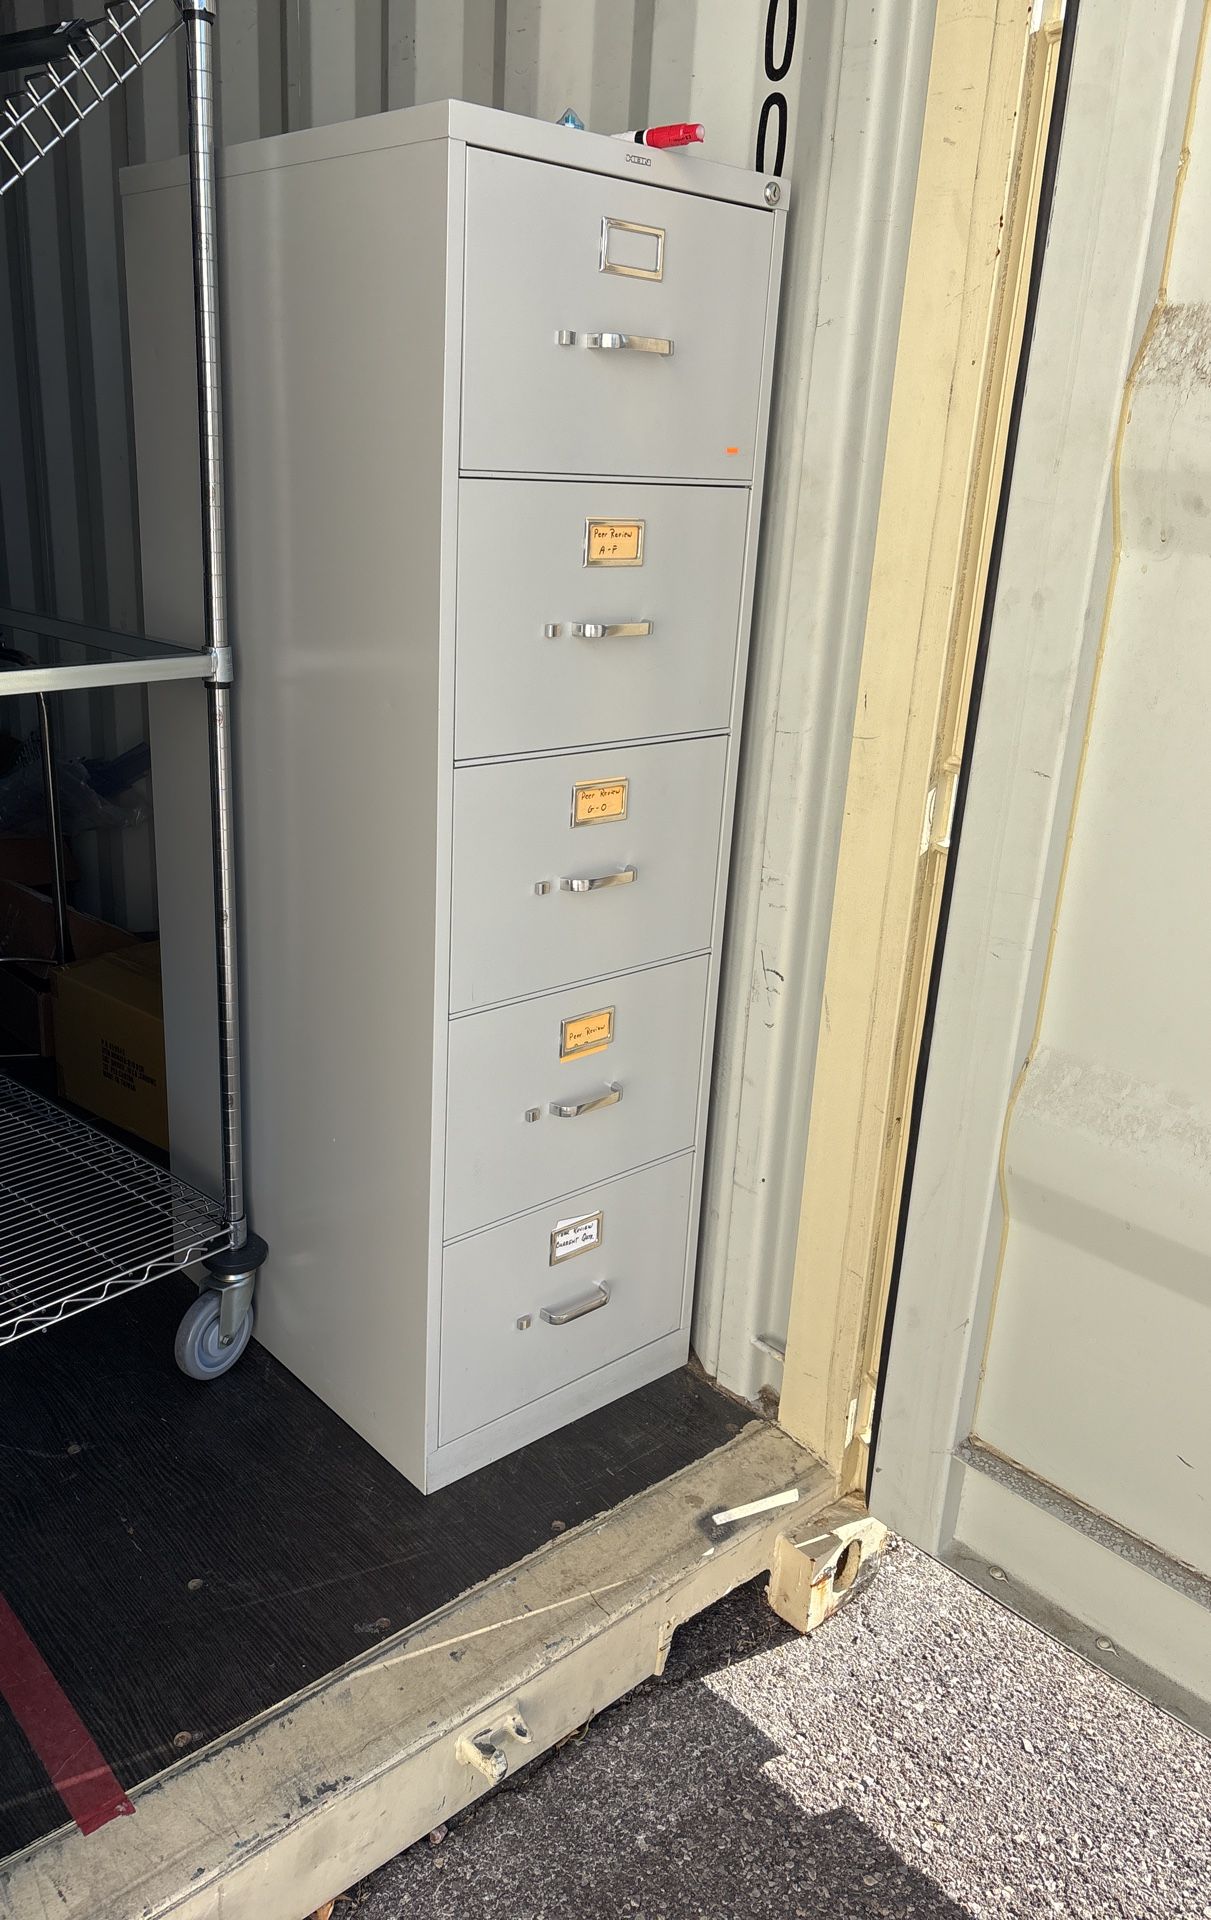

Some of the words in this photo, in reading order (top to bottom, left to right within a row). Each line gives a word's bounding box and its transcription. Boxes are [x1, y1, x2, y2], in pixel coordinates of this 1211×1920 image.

[594, 527, 608, 538] Peer
[609, 528, 633, 538] Review
[581, 791, 595, 800] Peer
[599, 788, 621, 797] Review
[569, 1032, 582, 1041] Peer
[584, 1024, 605, 1036] Review
